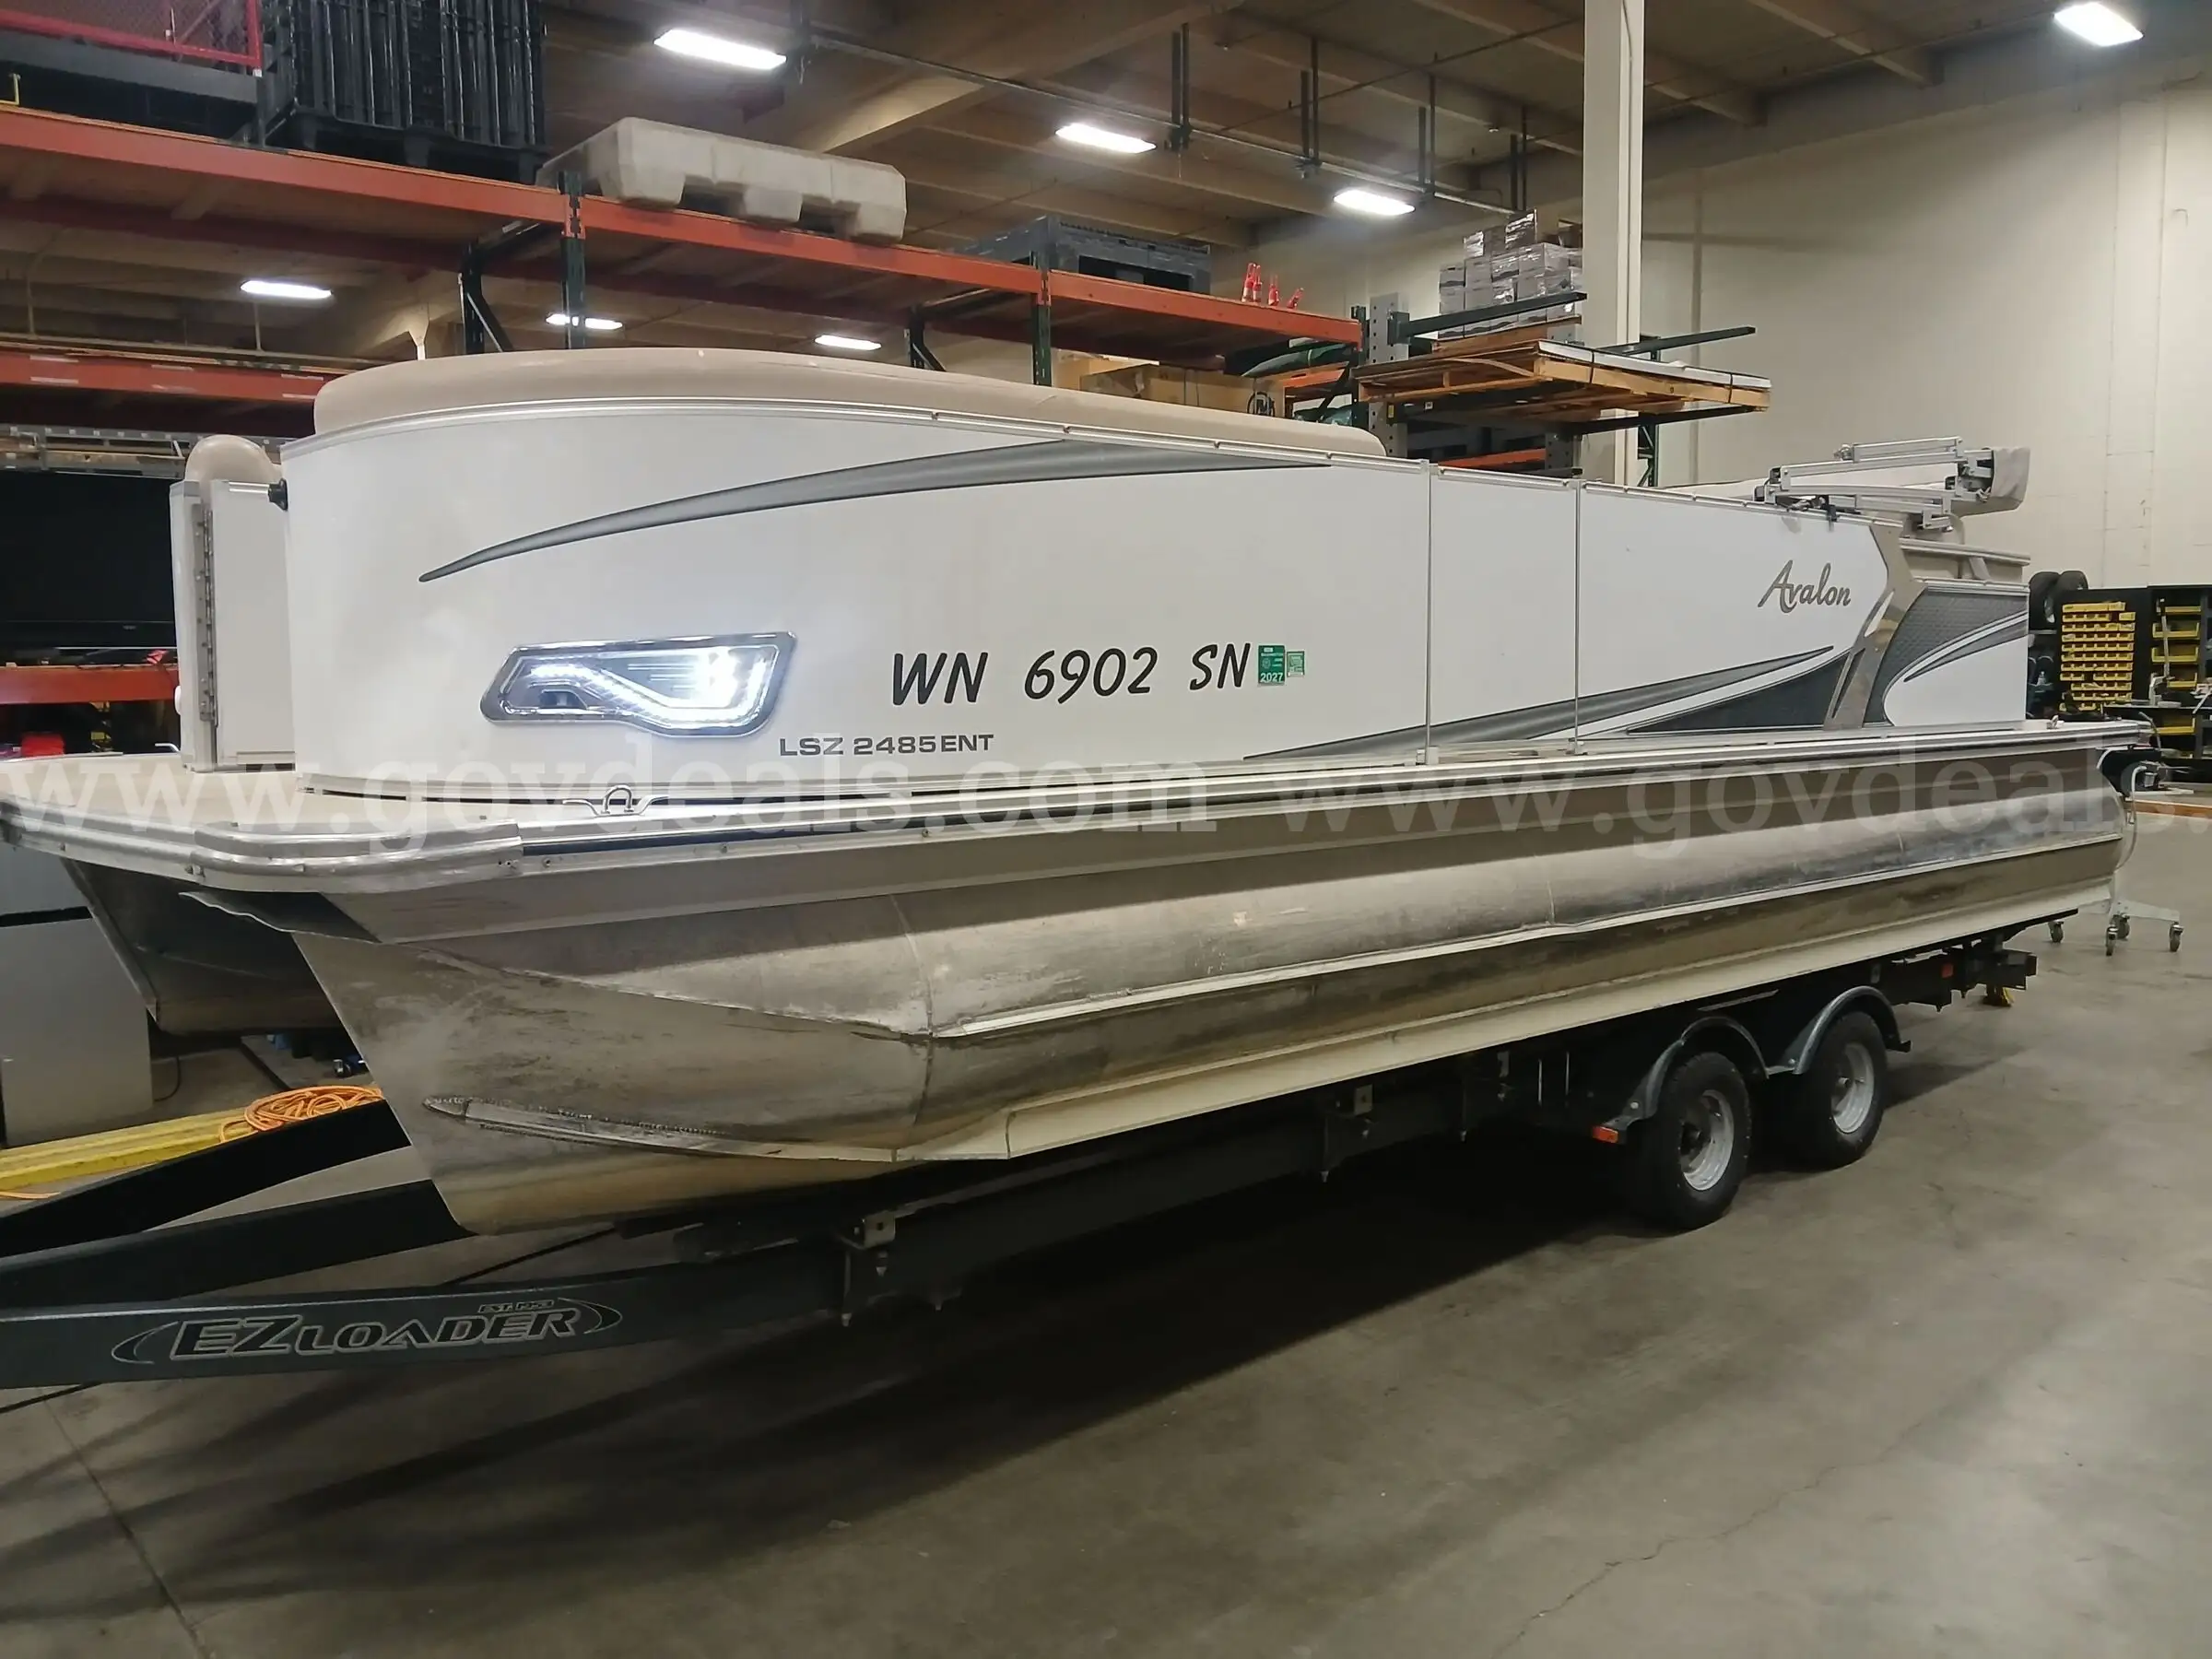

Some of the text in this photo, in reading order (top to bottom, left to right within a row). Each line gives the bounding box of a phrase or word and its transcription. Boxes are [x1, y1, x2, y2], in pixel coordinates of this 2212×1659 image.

[1757, 559, 1852, 614] Avalon
[891, 641, 1252, 706] WN 6902 SN
[1259, 671, 1285, 684] 2027
[779, 734, 994, 757] LSZ 2485ENT
